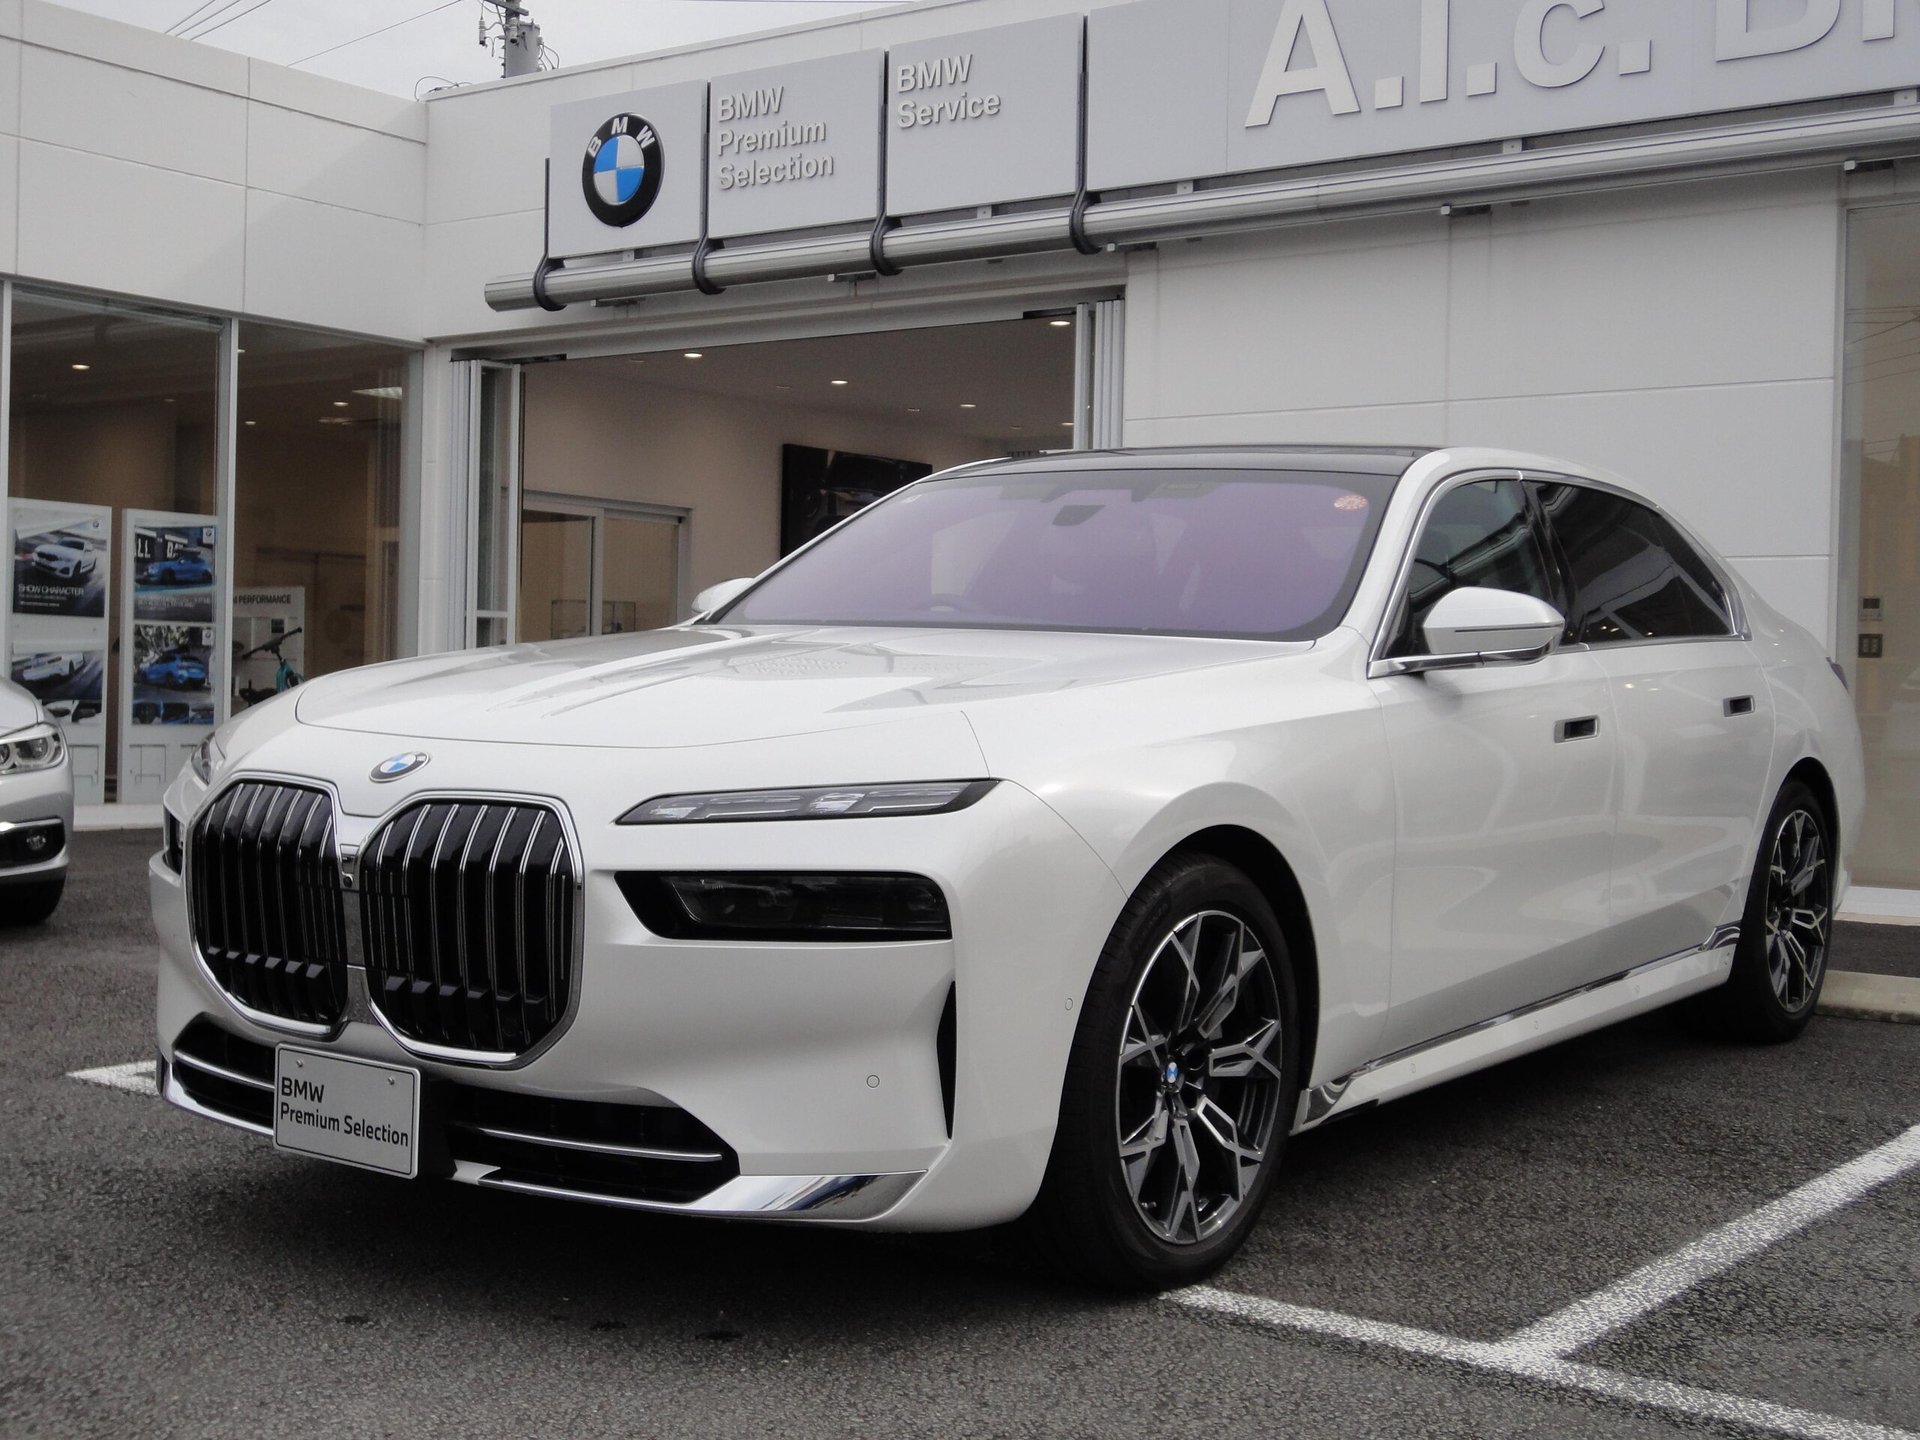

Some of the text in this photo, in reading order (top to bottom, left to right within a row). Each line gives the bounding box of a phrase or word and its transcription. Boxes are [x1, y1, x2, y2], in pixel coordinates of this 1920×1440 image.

[897, 53, 973, 94] BMW
[718, 86, 785, 123] BMW
[898, 92, 1002, 130] Service
[587, 116, 656, 158] BMW
[718, 120, 827, 157] Premium
[718, 153, 835, 191] Selection
[239, 593, 291, 605] PERFORMANCE
[281, 1076, 325, 1103] BMW
[280, 1101, 409, 1147] Premium Selection
